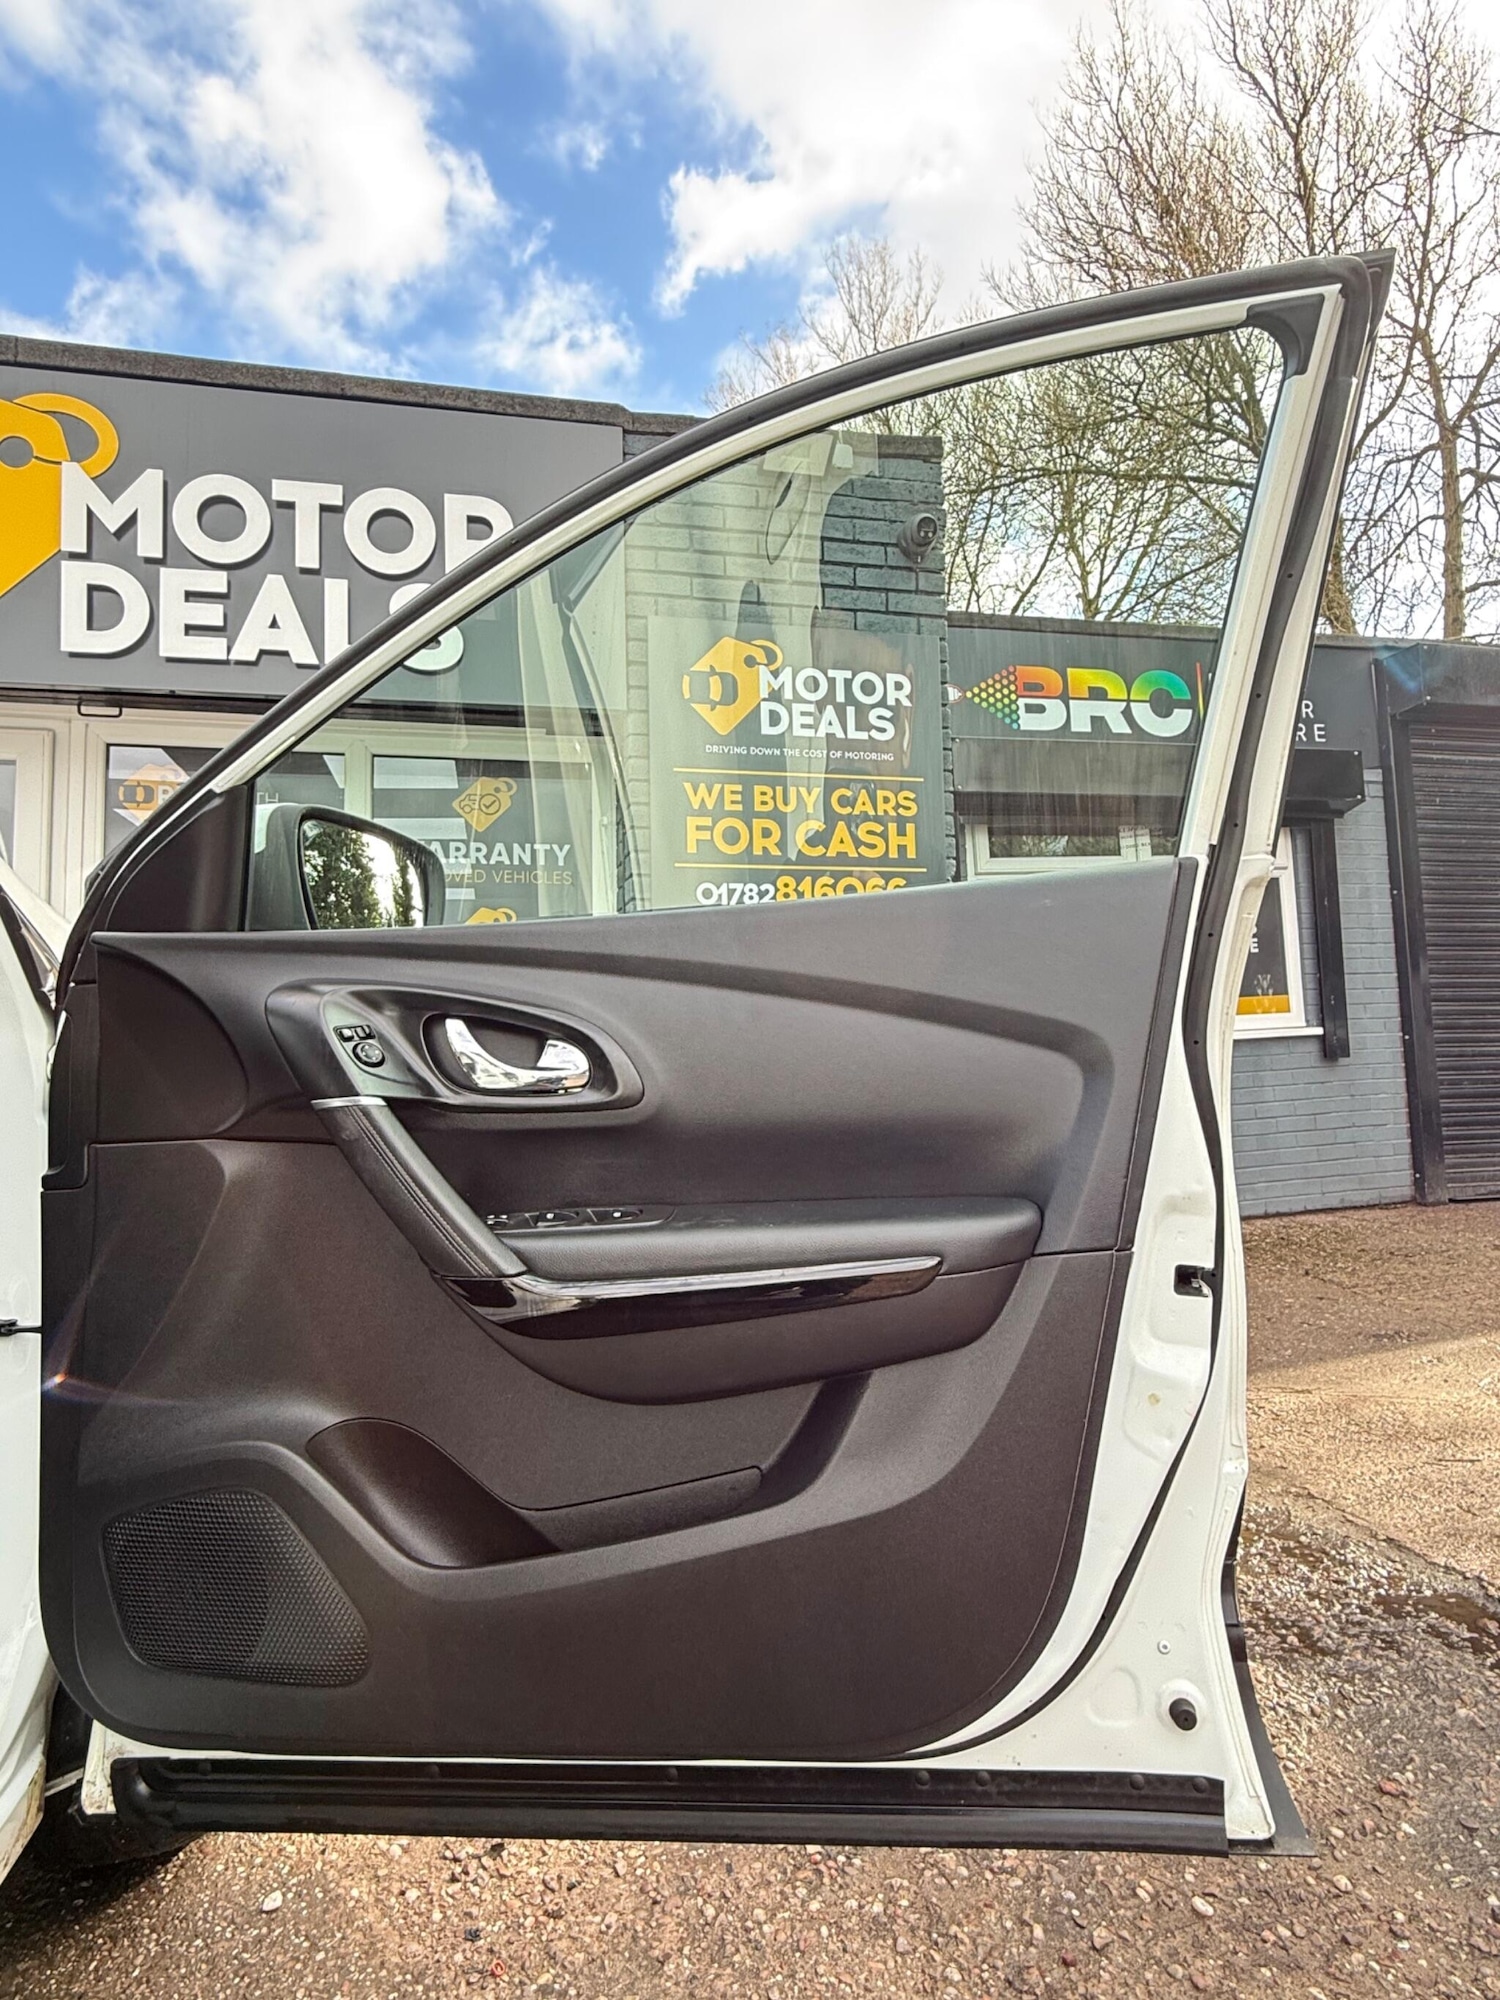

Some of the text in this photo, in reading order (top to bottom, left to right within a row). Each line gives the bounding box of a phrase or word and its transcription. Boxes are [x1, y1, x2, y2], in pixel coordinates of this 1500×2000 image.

[759, 665, 913, 707] MOTOR
[1015, 665, 1193, 737] BRC
[760, 701, 896, 742] DEALS
[705, 744, 895, 762] DRIVING DOWN THE COST OF MOTORING
[683, 782, 919, 817] WE BUY CARS
[421, 840, 572, 867] ARRANTY
[686, 816, 917, 859] FOR CASH
[493, 870, 573, 886] VEHICLES
